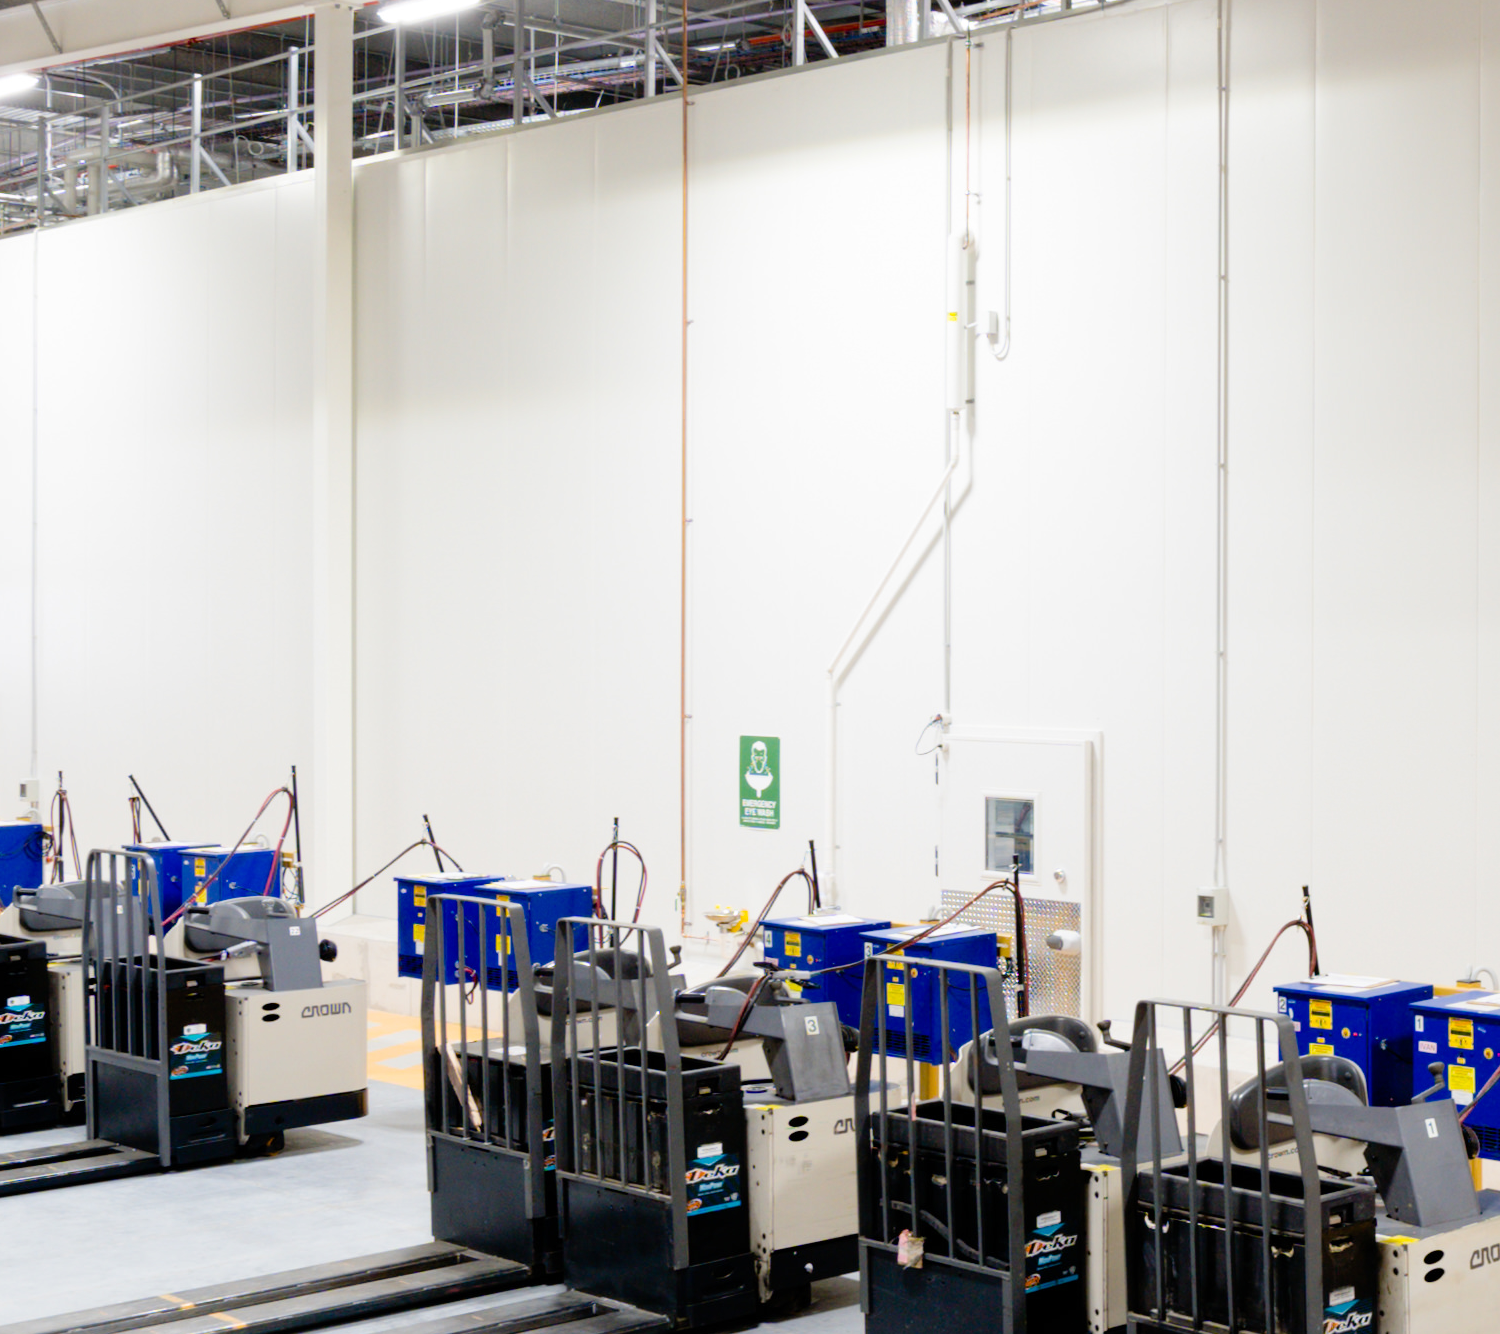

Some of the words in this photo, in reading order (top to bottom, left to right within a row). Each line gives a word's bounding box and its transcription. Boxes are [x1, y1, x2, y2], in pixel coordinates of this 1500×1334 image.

[301, 1002, 351, 1018] CROWN
[807, 1019, 817, 1033] 3
[686, 1164, 740, 1184] Deka
[1025, 1234, 1077, 1257] Deka
